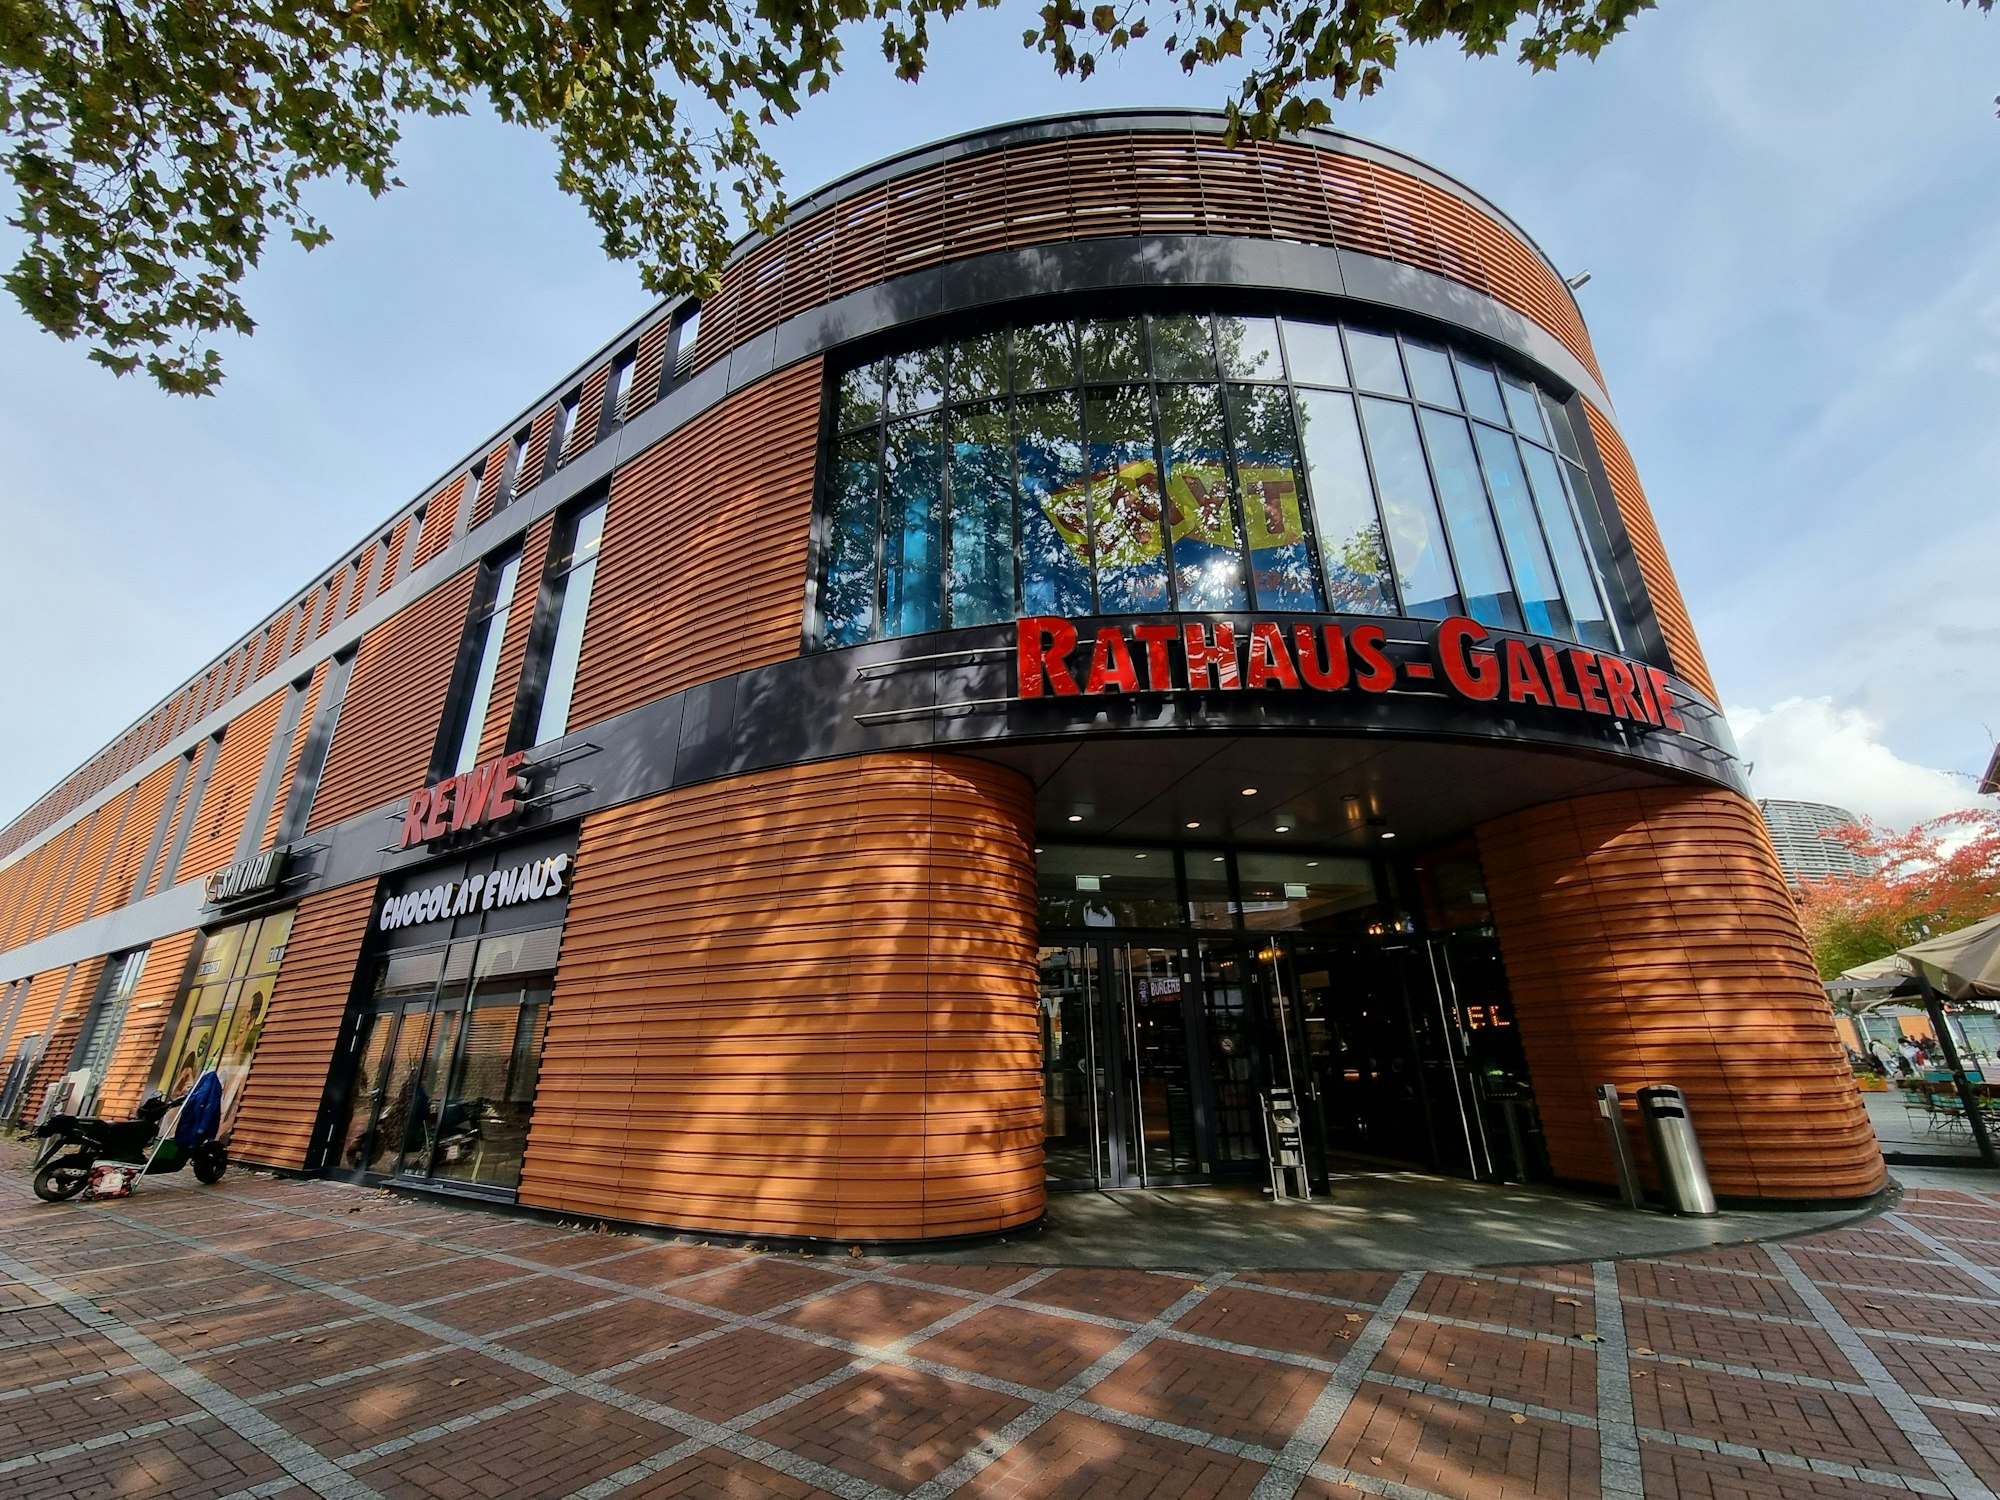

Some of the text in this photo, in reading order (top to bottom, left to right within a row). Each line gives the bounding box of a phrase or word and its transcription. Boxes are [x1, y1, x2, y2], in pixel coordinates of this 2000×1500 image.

[1017, 616, 1685, 732] RATHAUS-GALERIE
[400, 751, 525, 848] REWE
[217, 851, 276, 900] SATURN
[380, 853, 568, 931] CHOCOLATEHAUS
